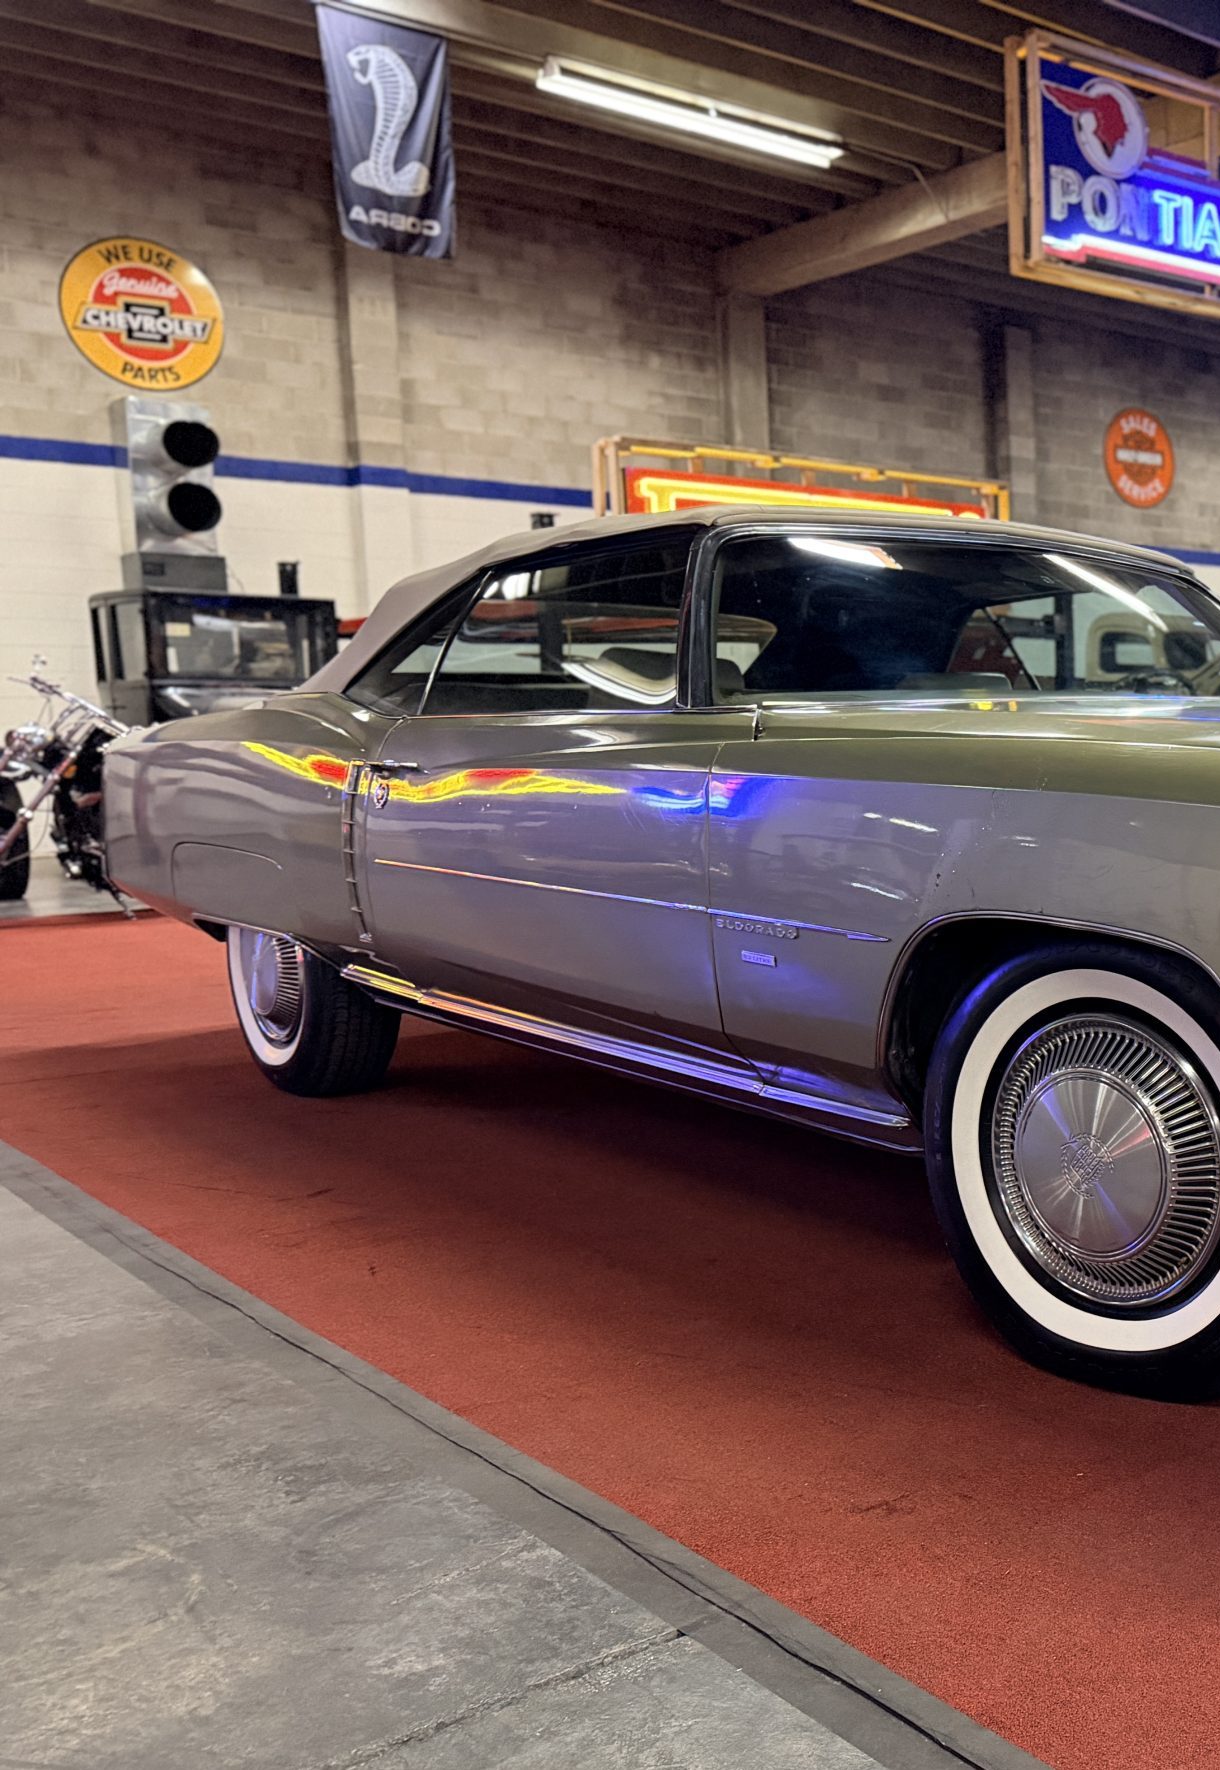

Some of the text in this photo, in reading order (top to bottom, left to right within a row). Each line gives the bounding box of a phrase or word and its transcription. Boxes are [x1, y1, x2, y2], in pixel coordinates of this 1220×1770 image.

[97, 244, 178, 272] WE USE
[101, 270, 180, 299] Genuine
[83, 308, 209, 339] CHEVROLET
[121, 361, 182, 384] PARTS
[1120, 414, 1157, 438] SALES
[715, 918, 797, 939] ELDORADO
